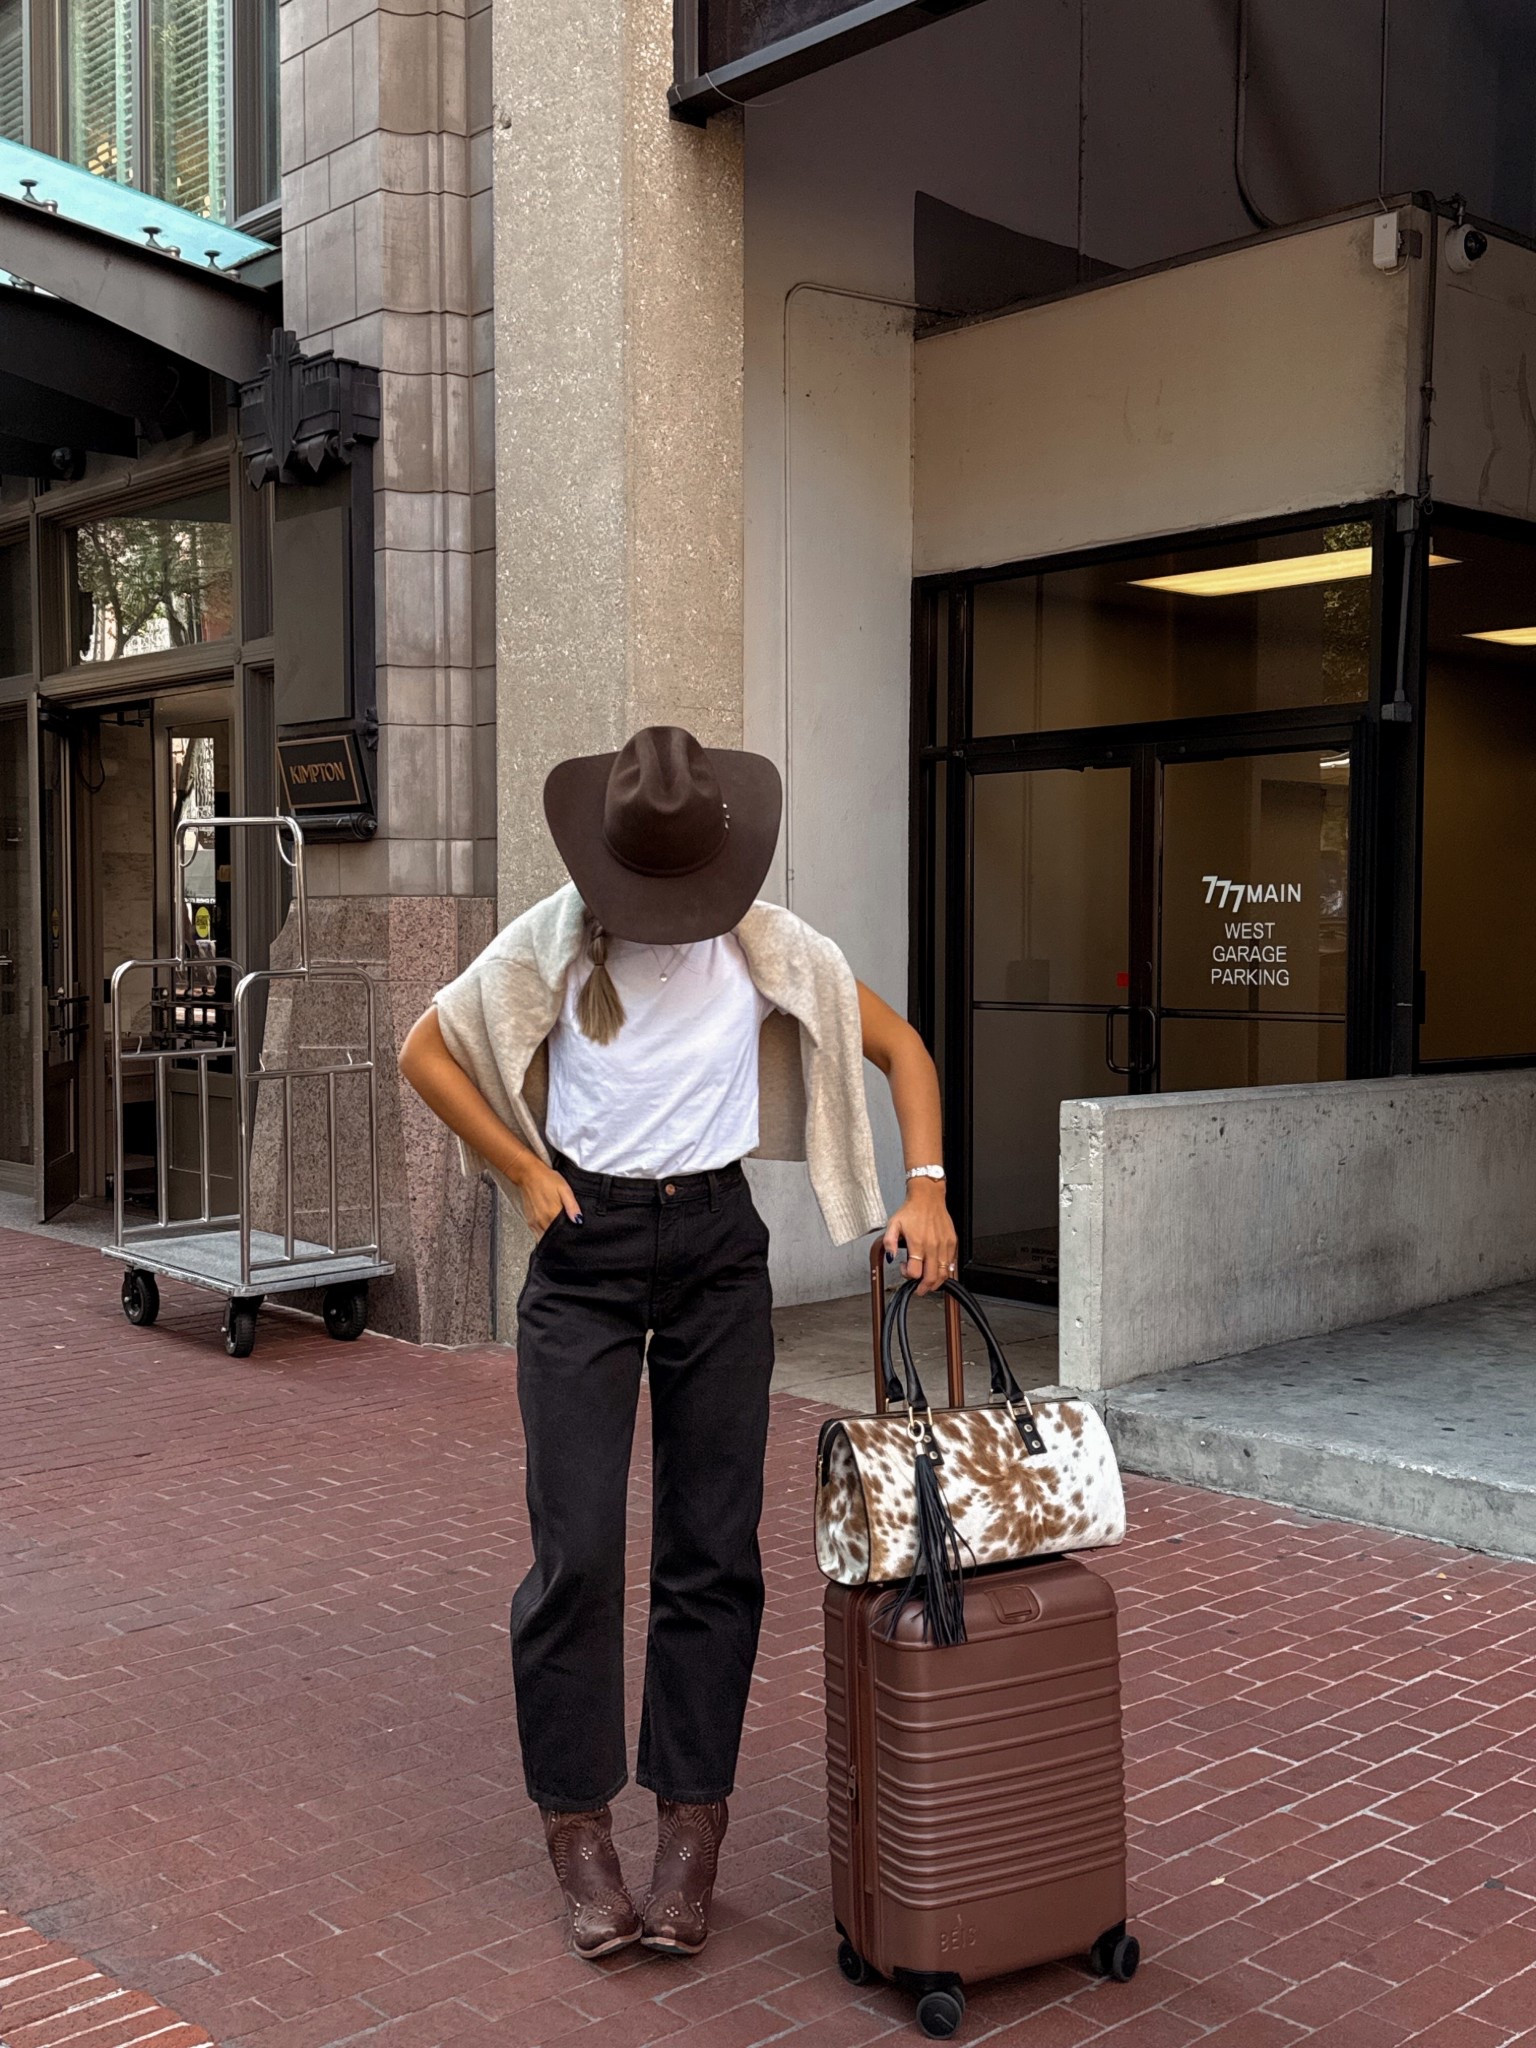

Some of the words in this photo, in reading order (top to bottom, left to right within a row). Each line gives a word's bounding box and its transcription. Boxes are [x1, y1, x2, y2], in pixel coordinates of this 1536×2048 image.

[289, 761, 346, 784] KIMPTON
[1224, 922, 1276, 939] WEST
[1212, 945, 1288, 963] GARAGE
[1211, 968, 1290, 986] PARKING
